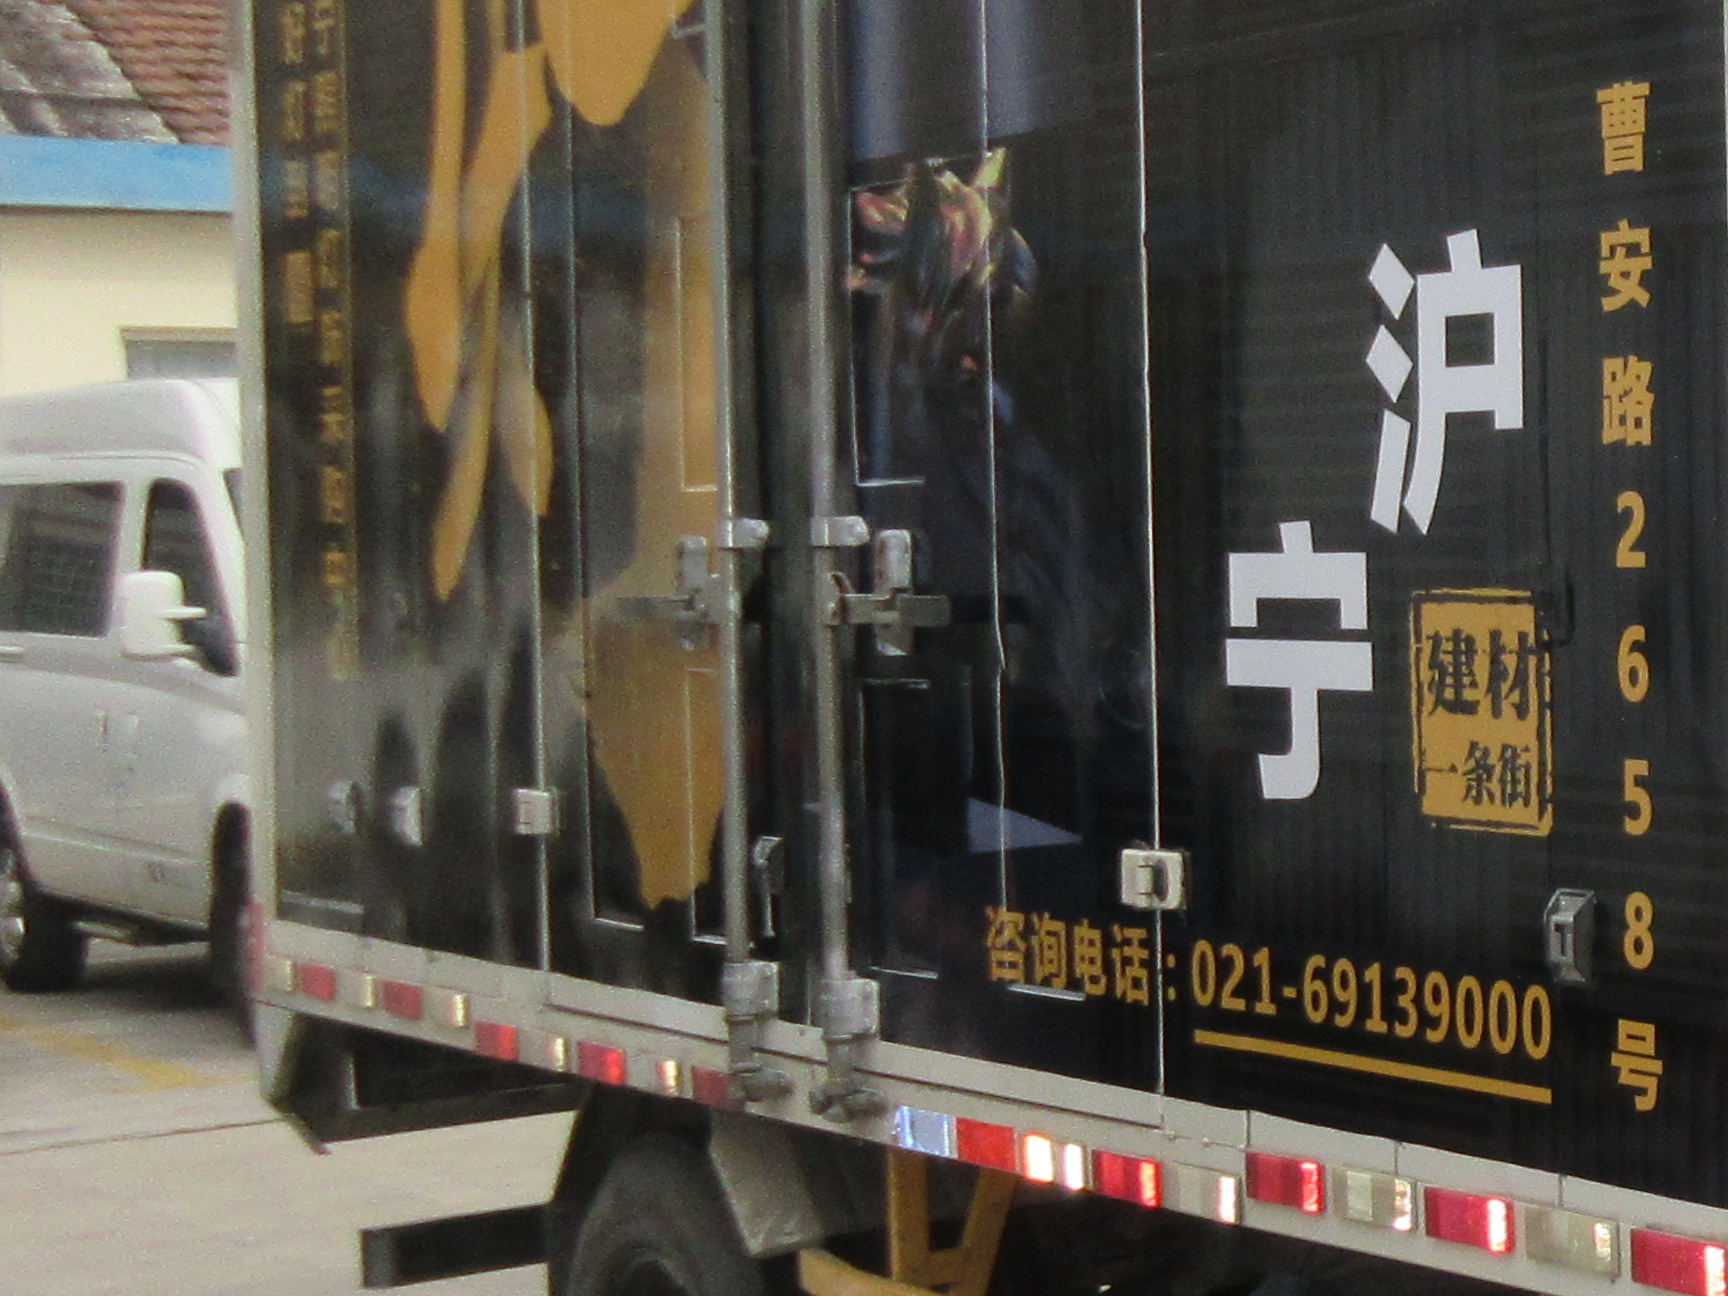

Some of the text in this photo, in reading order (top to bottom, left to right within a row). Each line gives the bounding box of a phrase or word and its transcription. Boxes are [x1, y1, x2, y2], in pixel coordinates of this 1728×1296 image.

[1225, 229, 1523, 799] 沪宁
[1596, 81, 1662, 1110] 曹安路2658号
